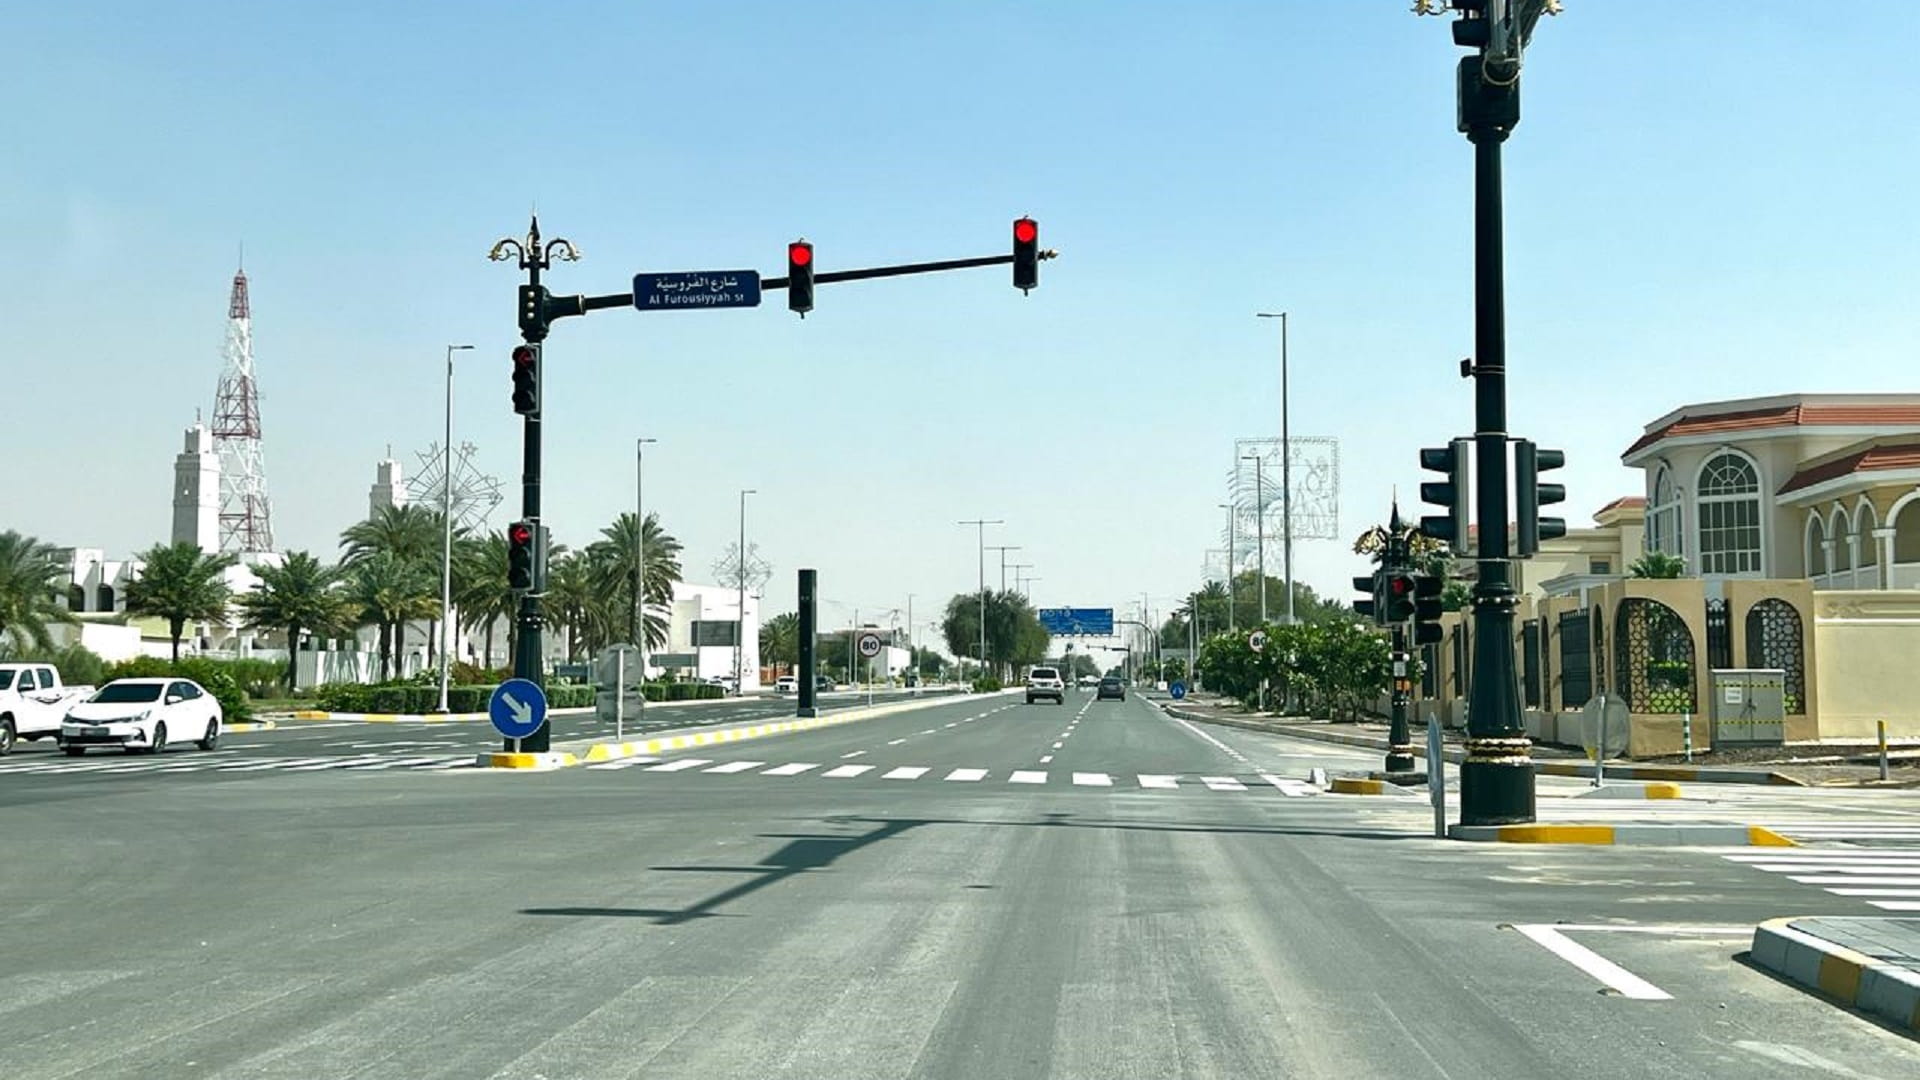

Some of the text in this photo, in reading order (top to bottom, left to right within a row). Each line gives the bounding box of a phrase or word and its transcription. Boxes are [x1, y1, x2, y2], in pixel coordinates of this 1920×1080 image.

[710, 276, 738, 292] شارع
[649, 294, 661, 305] Al
[664, 292, 730, 305] Furousiyyah
[862, 641, 877, 650] 80
